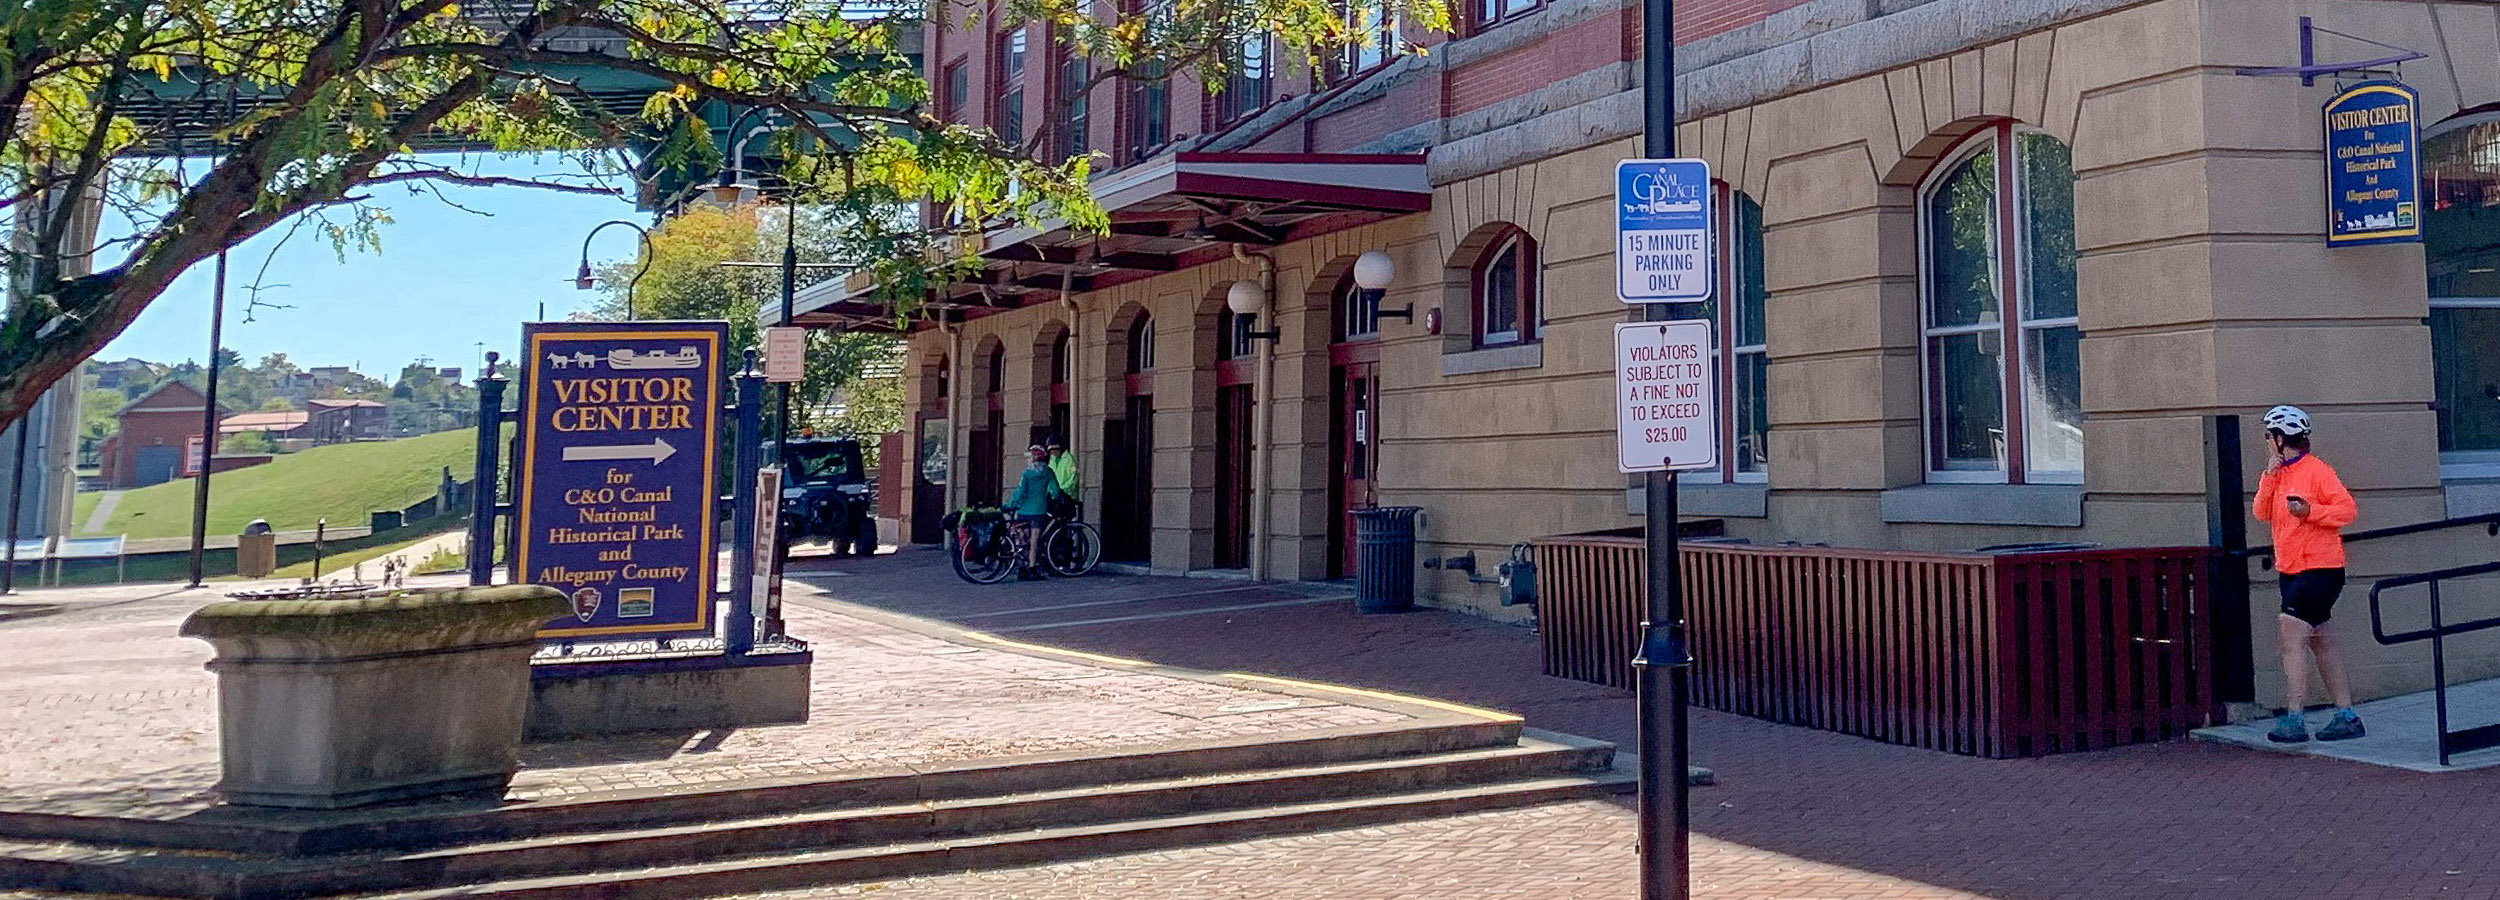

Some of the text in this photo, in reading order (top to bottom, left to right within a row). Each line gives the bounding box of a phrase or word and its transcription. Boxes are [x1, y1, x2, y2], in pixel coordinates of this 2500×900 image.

[2331, 104, 2409, 132] VISITOR CENTER
[2337, 146, 2353, 159] C&O
[2354, 143, 2374, 156] Canal
[2380, 157, 2396, 169] Park
[1632, 173, 1680, 200] CANAL
[2374, 188, 2400, 201] County
[1649, 184, 1700, 214] PLACE
[1629, 233, 1699, 251] 15 MINUTE
[1635, 253, 1693, 271] PARKING
[1648, 274, 1681, 291] ONLY
[1630, 344, 1697, 361] VIOLATORS
[1627, 363, 1702, 382] SUBJECT TO
[552, 377, 693, 404] VISITOR
[1630, 383, 1700, 401] A FINE NOT
[552, 405, 693, 432] CENTER
[1630, 402, 1700, 421] TO EXCEED
[1645, 426, 1687, 443] $25.00
[606, 468, 633, 484] for
[564, 486, 672, 505] C&O Canal
[579, 505, 656, 523] National
[549, 524, 684, 544] Historical Park
[598, 544, 632, 562] and
[538, 564, 689, 585] Allegany County
